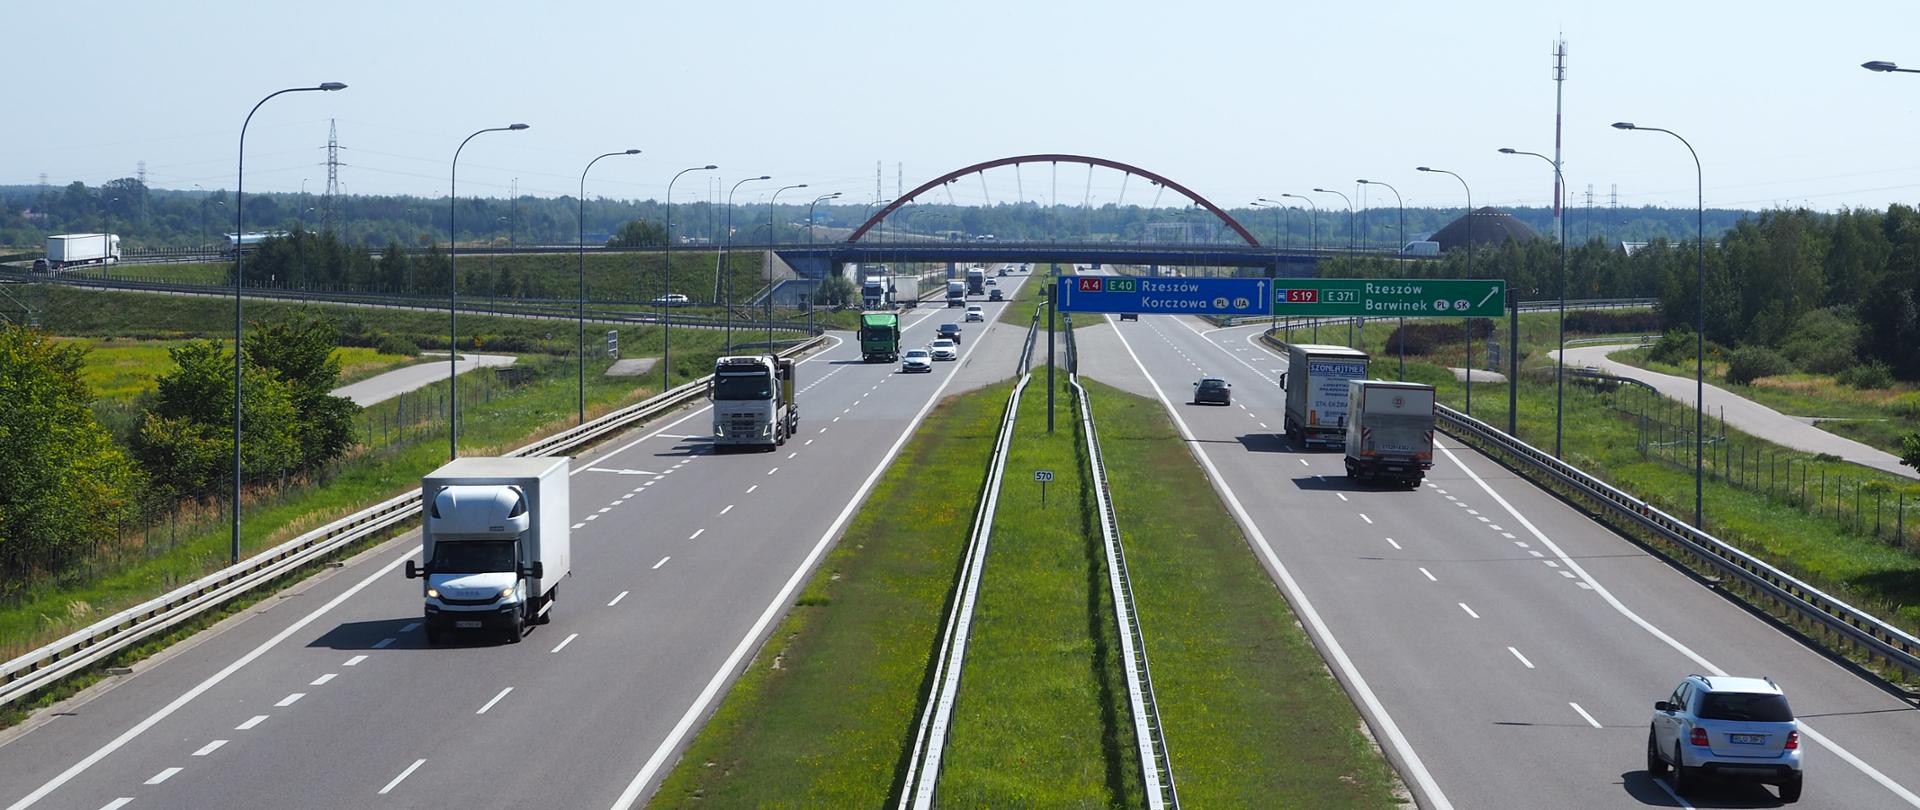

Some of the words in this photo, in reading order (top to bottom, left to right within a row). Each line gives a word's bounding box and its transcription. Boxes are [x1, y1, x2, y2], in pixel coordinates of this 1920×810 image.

[1082, 280, 1090, 290] A
[1092, 280, 1099, 290] 4
[1110, 280, 1116, 290] E
[1118, 280, 1132, 290] 40
[1142, 280, 1200, 292] Rzeszów
[1365, 282, 1423, 294] Rzeszów
[1292, 291, 1298, 301] S
[1301, 291, 1313, 301] 19
[1328, 291, 1334, 301] E
[1336, 291, 1354, 301] 371
[1142, 296, 1207, 308] Korczowa
[1216, 299, 1227, 307] PL
[1235, 299, 1247, 308] UA
[1365, 299, 1428, 311] Barwinek
[1436, 301, 1446, 309] PL
[1456, 301, 1468, 309] SK
[1035, 471, 1052, 480] 570
